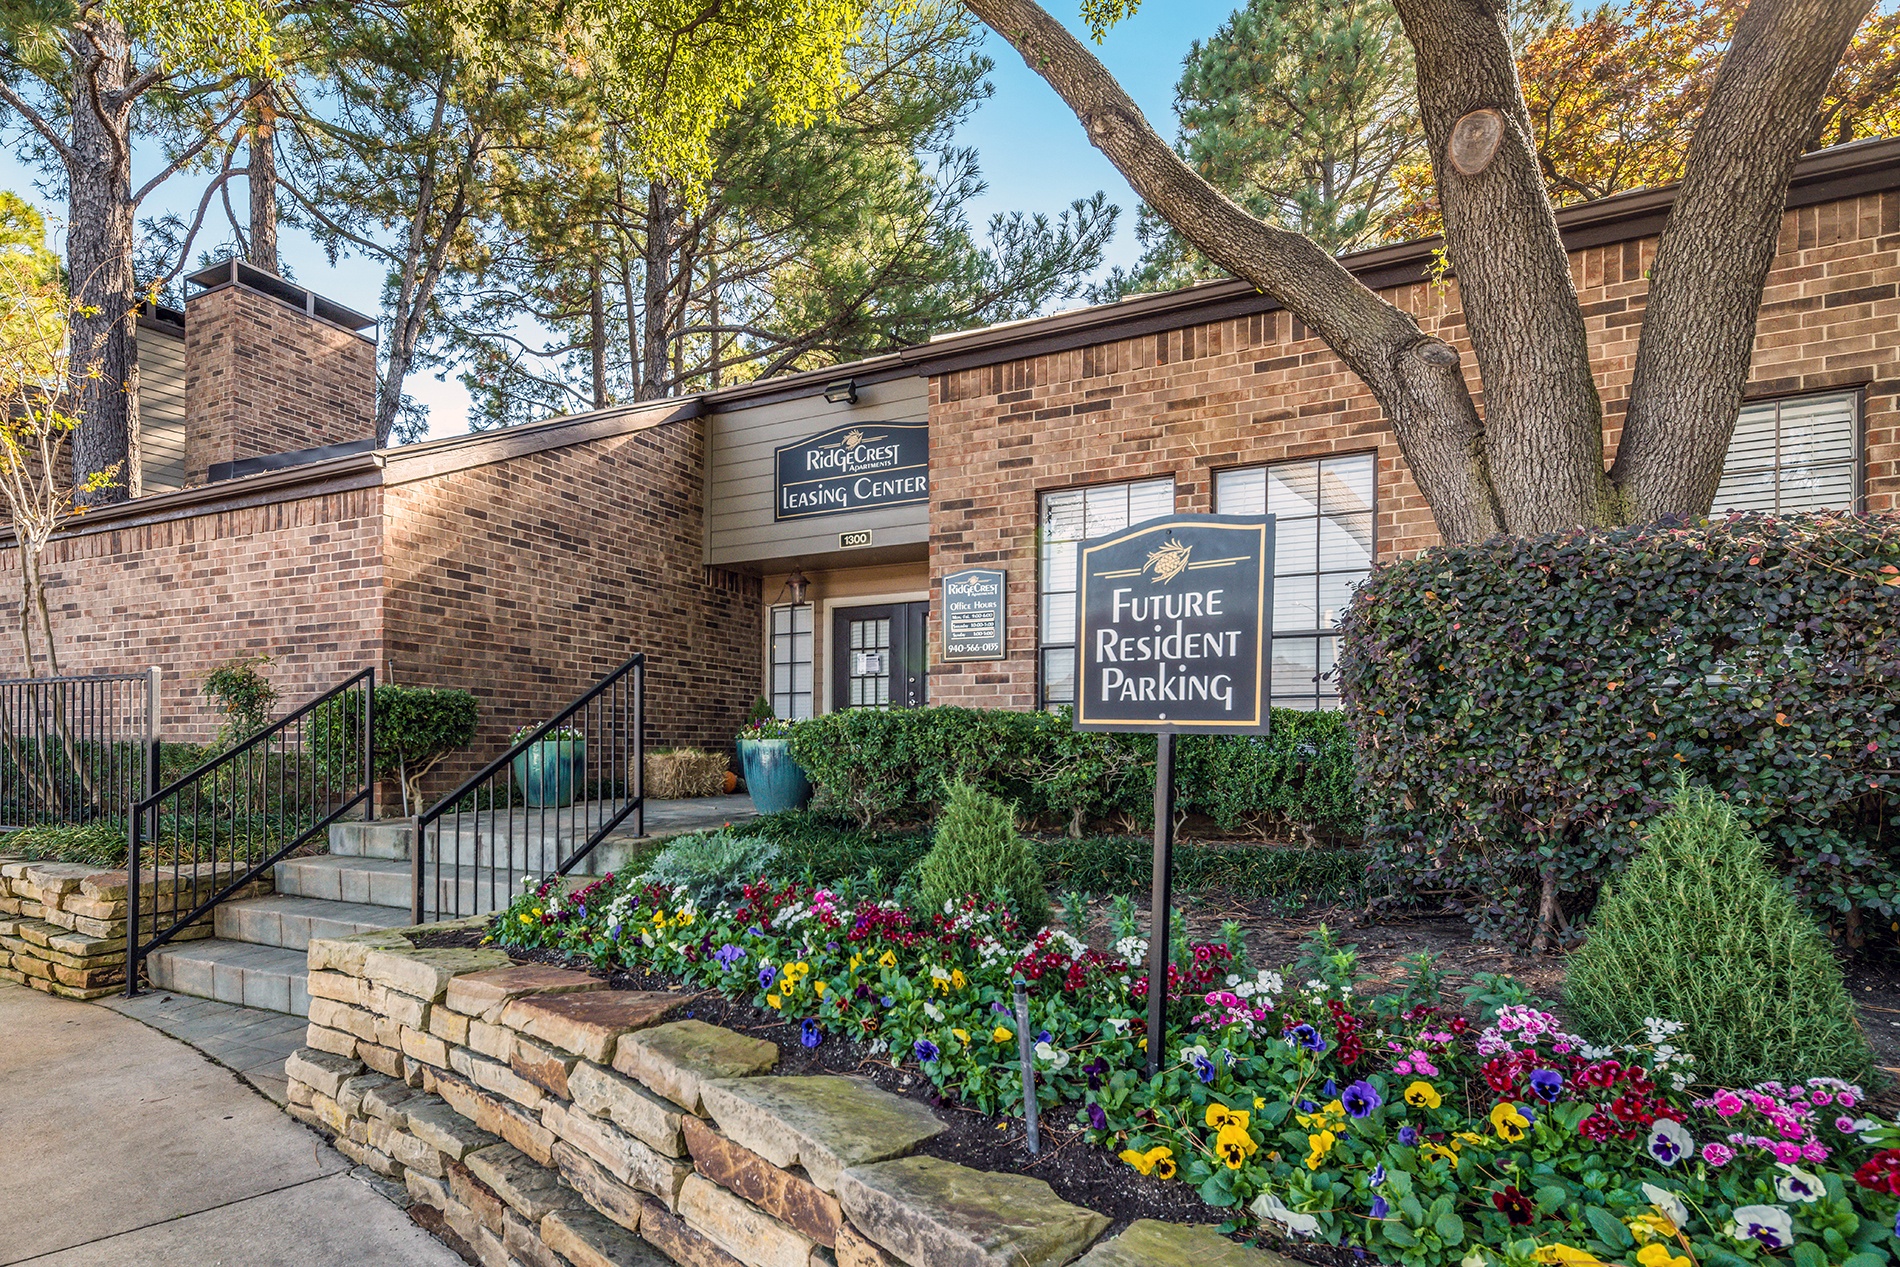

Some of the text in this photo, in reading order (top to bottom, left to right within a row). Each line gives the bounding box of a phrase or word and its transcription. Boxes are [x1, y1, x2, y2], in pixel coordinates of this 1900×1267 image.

[854, 476, 927, 500] CENTER
[844, 533, 867, 545] 1300
[1112, 587, 1224, 623] FUTURE
